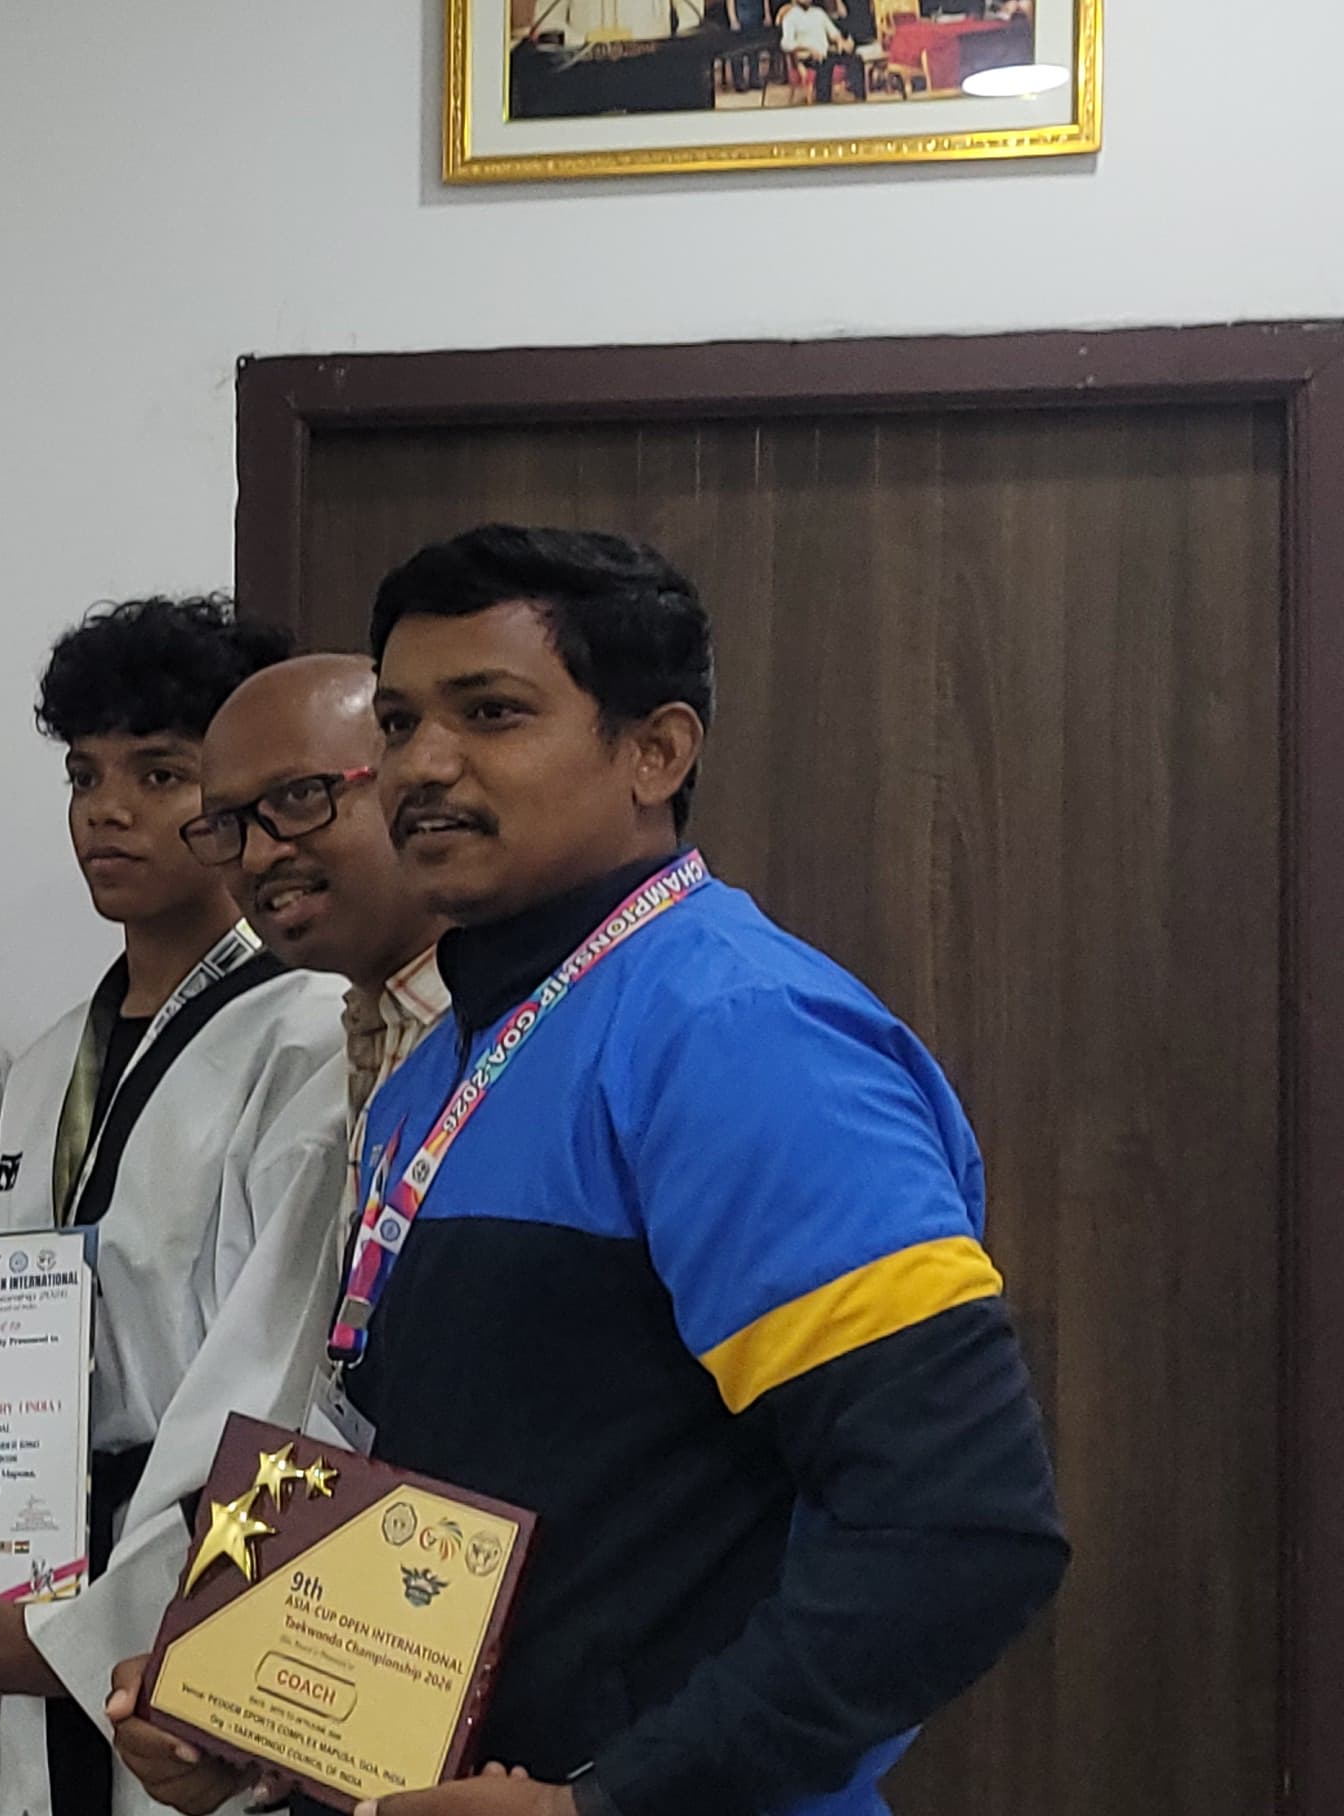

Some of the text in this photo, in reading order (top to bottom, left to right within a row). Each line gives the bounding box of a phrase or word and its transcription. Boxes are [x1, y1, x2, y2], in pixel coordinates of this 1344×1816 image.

[541, 858, 703, 1006] CHAMPIONSHIP
[10, 1271, 78, 1290] INTERNATIONAL
[290, 1571, 323, 1601] 9th
[285, 1594, 310, 1614] ASIA
[315, 1605, 338, 1622] CUP
[339, 1615, 370, 1637] OPEN
[372, 1627, 464, 1674] INTERNATIONAL
[285, 1615, 343, 1649] Taekwondo
[345, 1639, 422, 1682] Championship
[424, 1670, 453, 1692] 2026
[277, 1669, 336, 1705] COACH
[234, 1723, 286, 1754] TAEKWONDO
[287, 1747, 323, 1772] COUNCIL
[326, 1761, 338, 1776] OF
[339, 1767, 362, 1787] INDIA
[243, 1706, 276, 1732] SPORTS
[277, 1723, 318, 1750] COMPLEX
